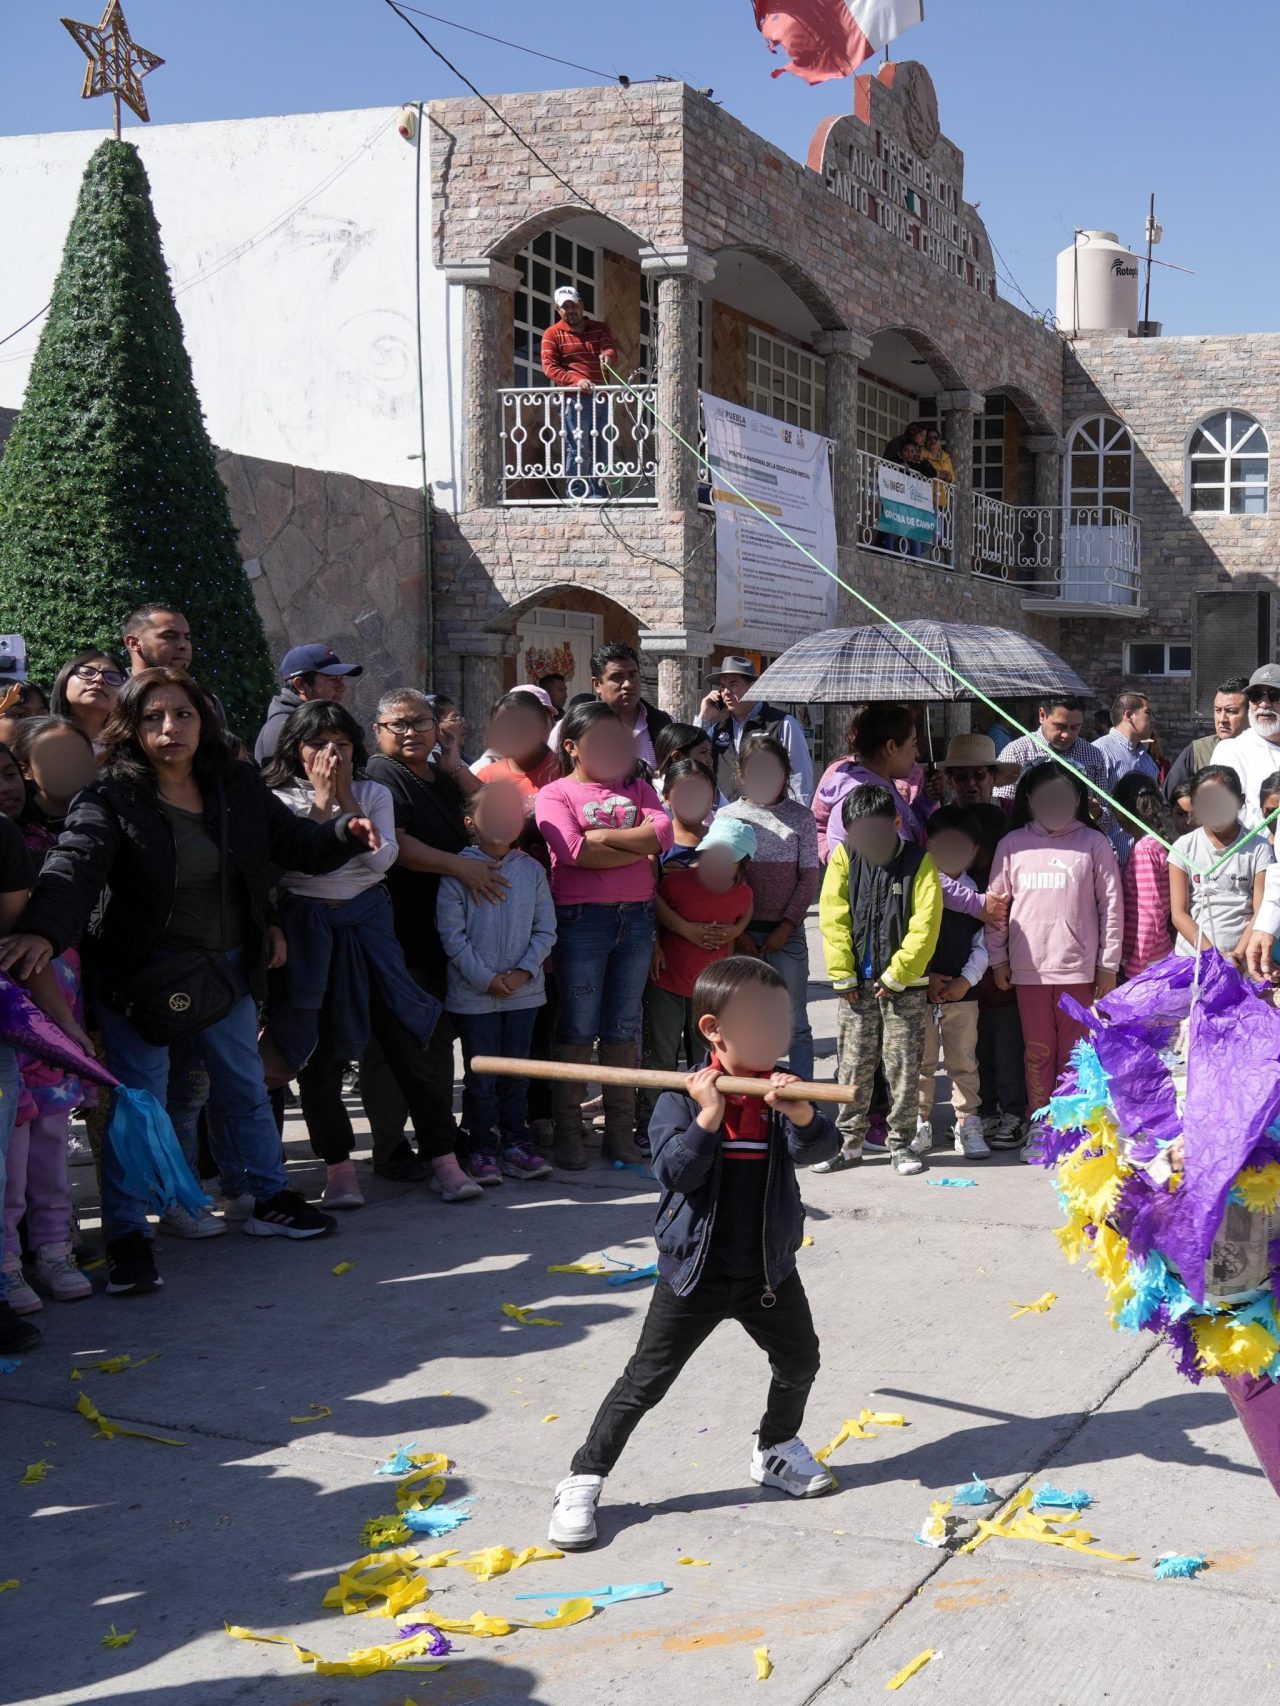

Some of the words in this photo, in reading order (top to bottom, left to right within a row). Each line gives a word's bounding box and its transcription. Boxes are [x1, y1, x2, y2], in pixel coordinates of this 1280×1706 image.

[851, 148, 908, 211] AUXILIAR
[882, 134, 957, 215] PRESIDENCIA
[826, 164, 869, 216] SANTO
[874, 198, 914, 249] TOMAS
[920, 229, 968, 285] CHAUTLA
[725, 410, 746, 424] PUEBLA
[906, 516, 915, 526] DE
